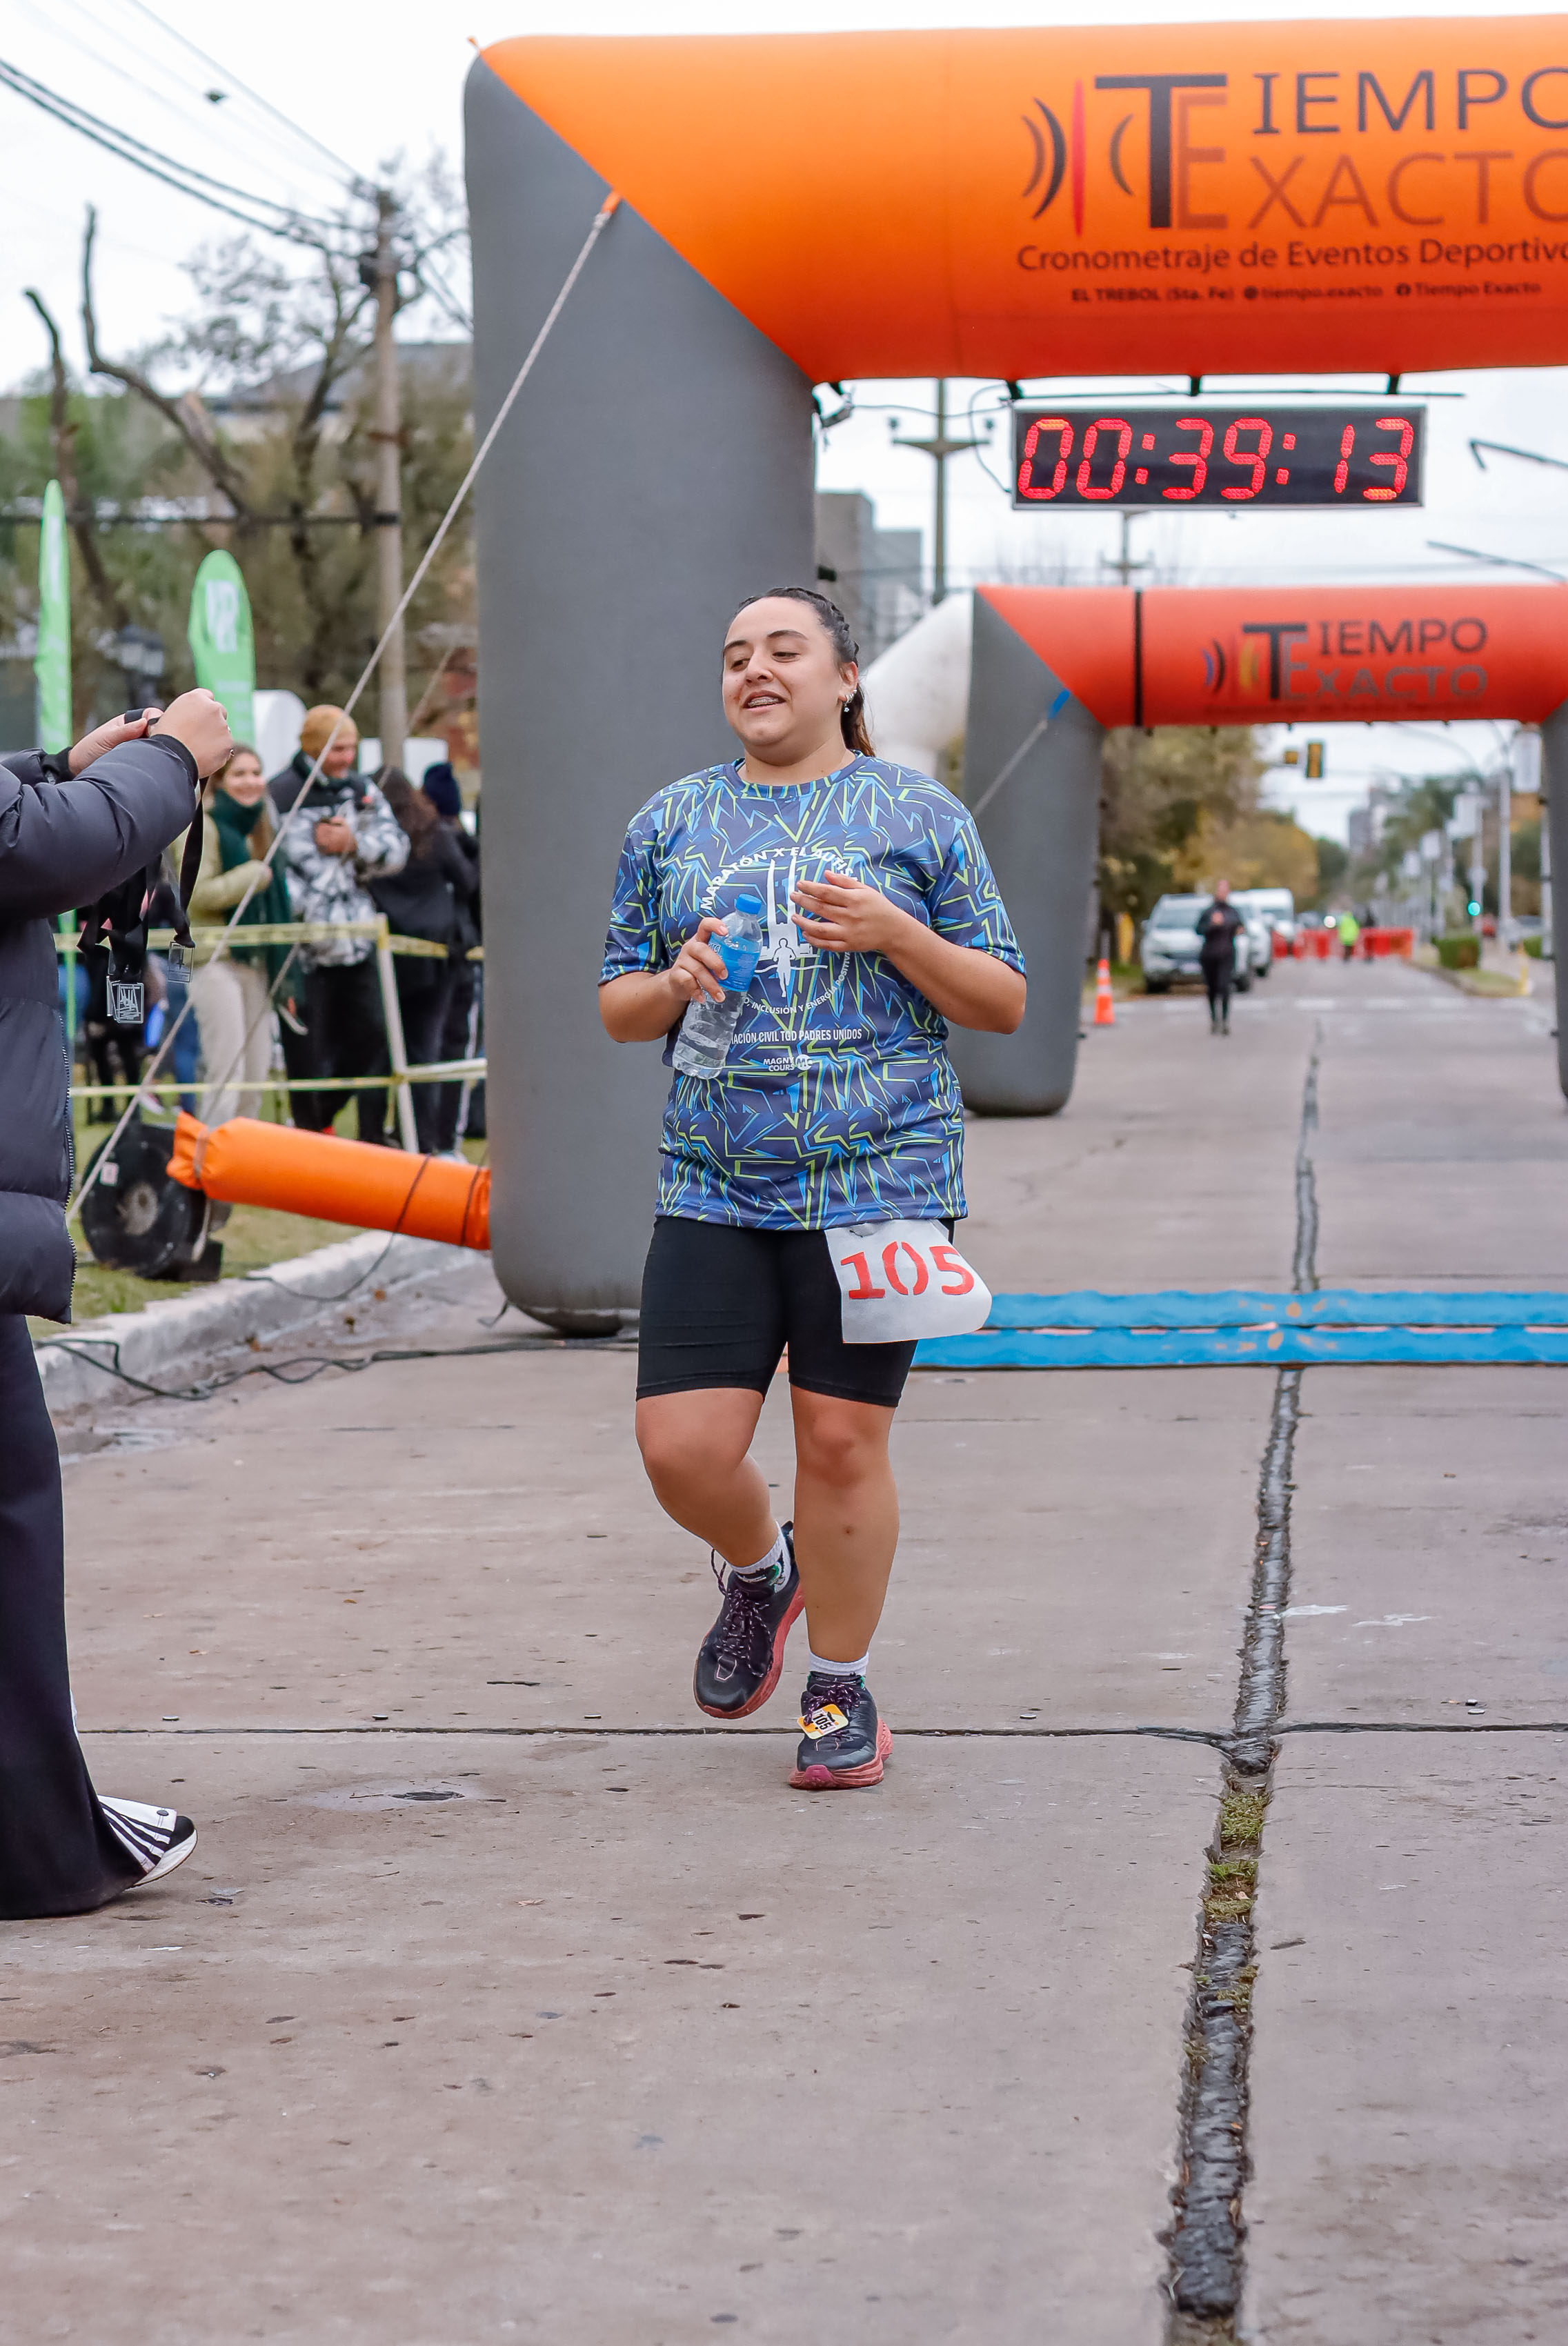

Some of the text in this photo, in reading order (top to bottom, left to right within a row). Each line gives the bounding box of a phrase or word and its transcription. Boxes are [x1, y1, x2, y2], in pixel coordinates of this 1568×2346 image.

[1017, 244, 1231, 273] Cronometraje
[1238, 242, 1278, 267] de
[1288, 241, 1409, 266] Eventos
[700, 846, 858, 910] MARATÓN X EL AUTIS
[751, 1002, 797, 1015] INCLUSIÓN
[806, 986, 837, 1010] ENERGÍA
[759, 1031, 779, 1043] CIVIL
[780, 1030, 796, 1042] TGD
[799, 1029, 831, 1040] PADRES
[833, 1028, 862, 1040] UNIDOS
[764, 1057, 795, 1065] MAGNY
[841, 1241, 974, 1299] 105
[813, 1713, 834, 1730] 105
